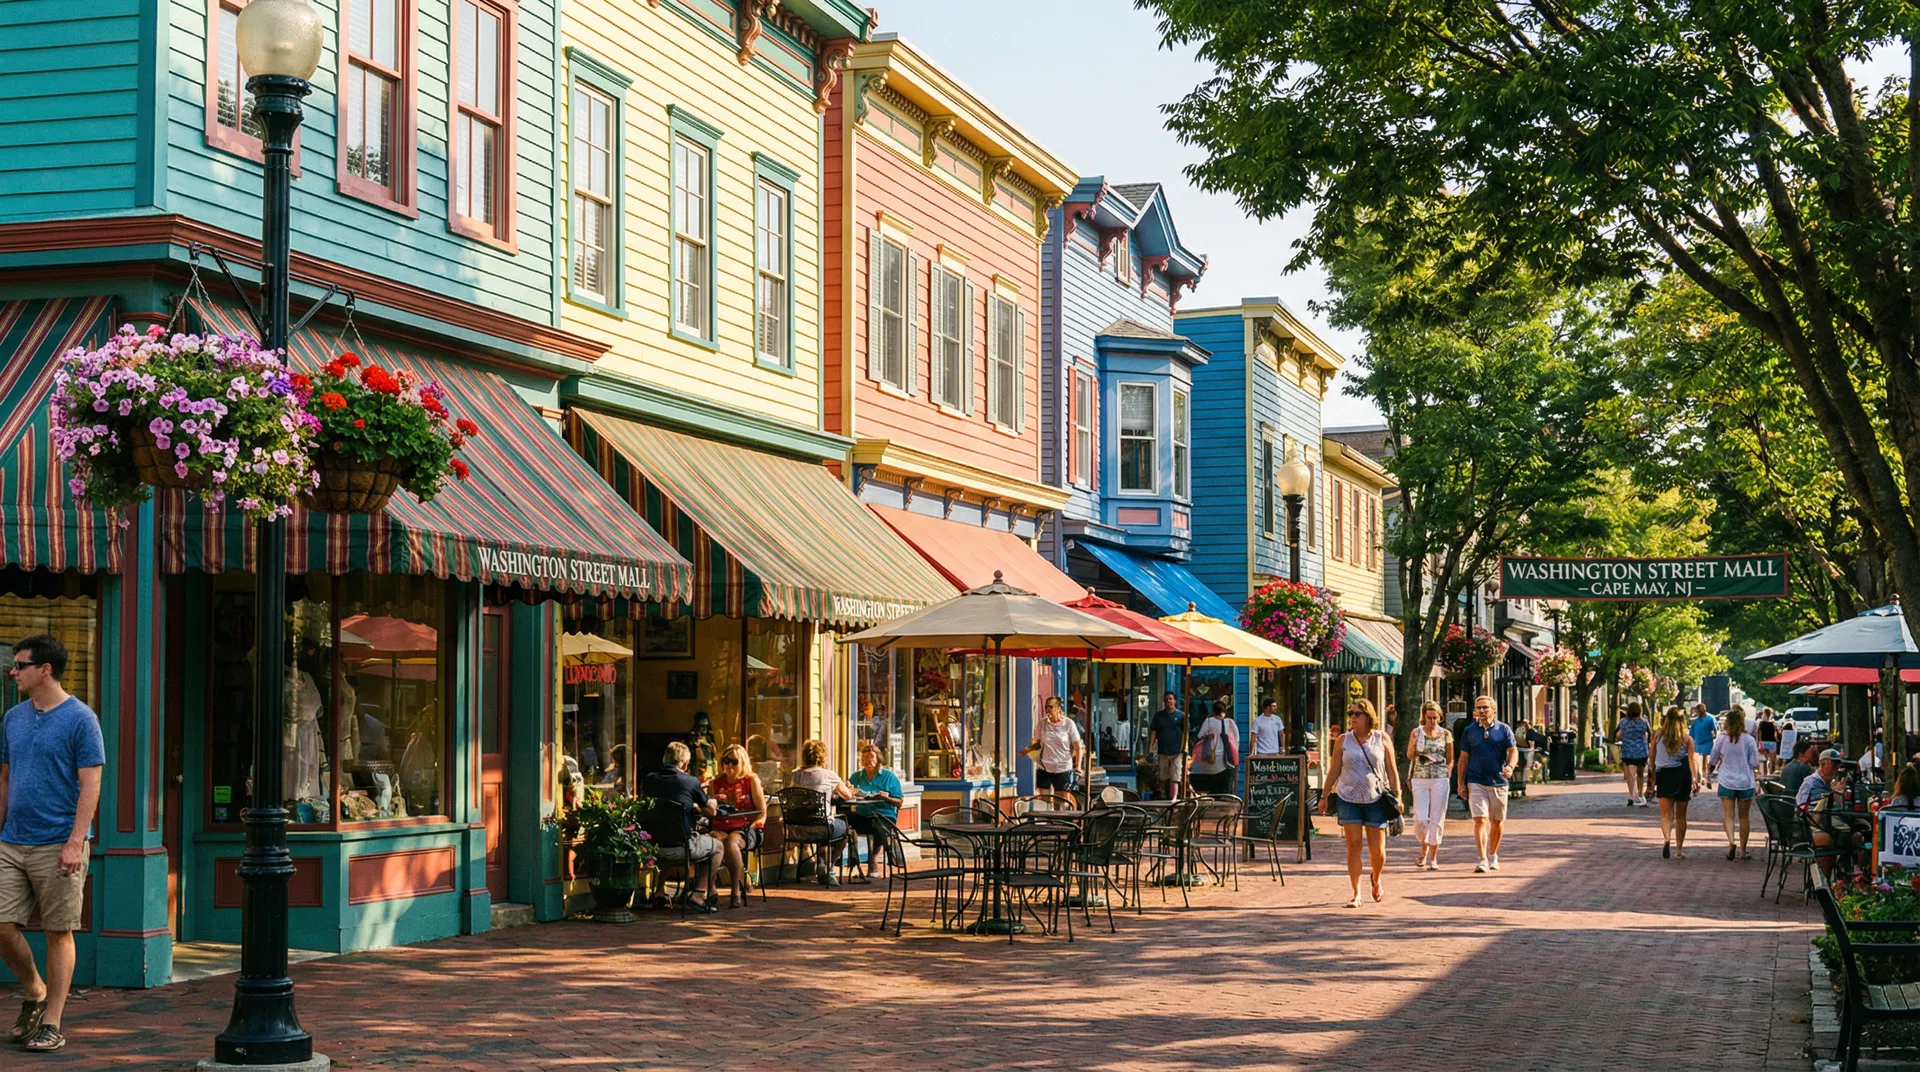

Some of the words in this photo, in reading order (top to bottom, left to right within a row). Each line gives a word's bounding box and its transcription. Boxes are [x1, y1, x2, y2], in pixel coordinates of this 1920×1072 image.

[477, 546, 568, 580] WASHINGTON
[570, 559, 616, 585] STREET
[618, 565, 650, 589] MALL
[1507, 562, 1642, 580] WASHINGTON
[1648, 561, 1718, 579] STREET
[1724, 560, 1778, 578] MALL
[1591, 582, 1630, 596] CAPE
[1634, 582, 1671, 597] MAY,
[1674, 581, 1692, 598] NJ
[833, 595, 885, 619] WASHINGTON
